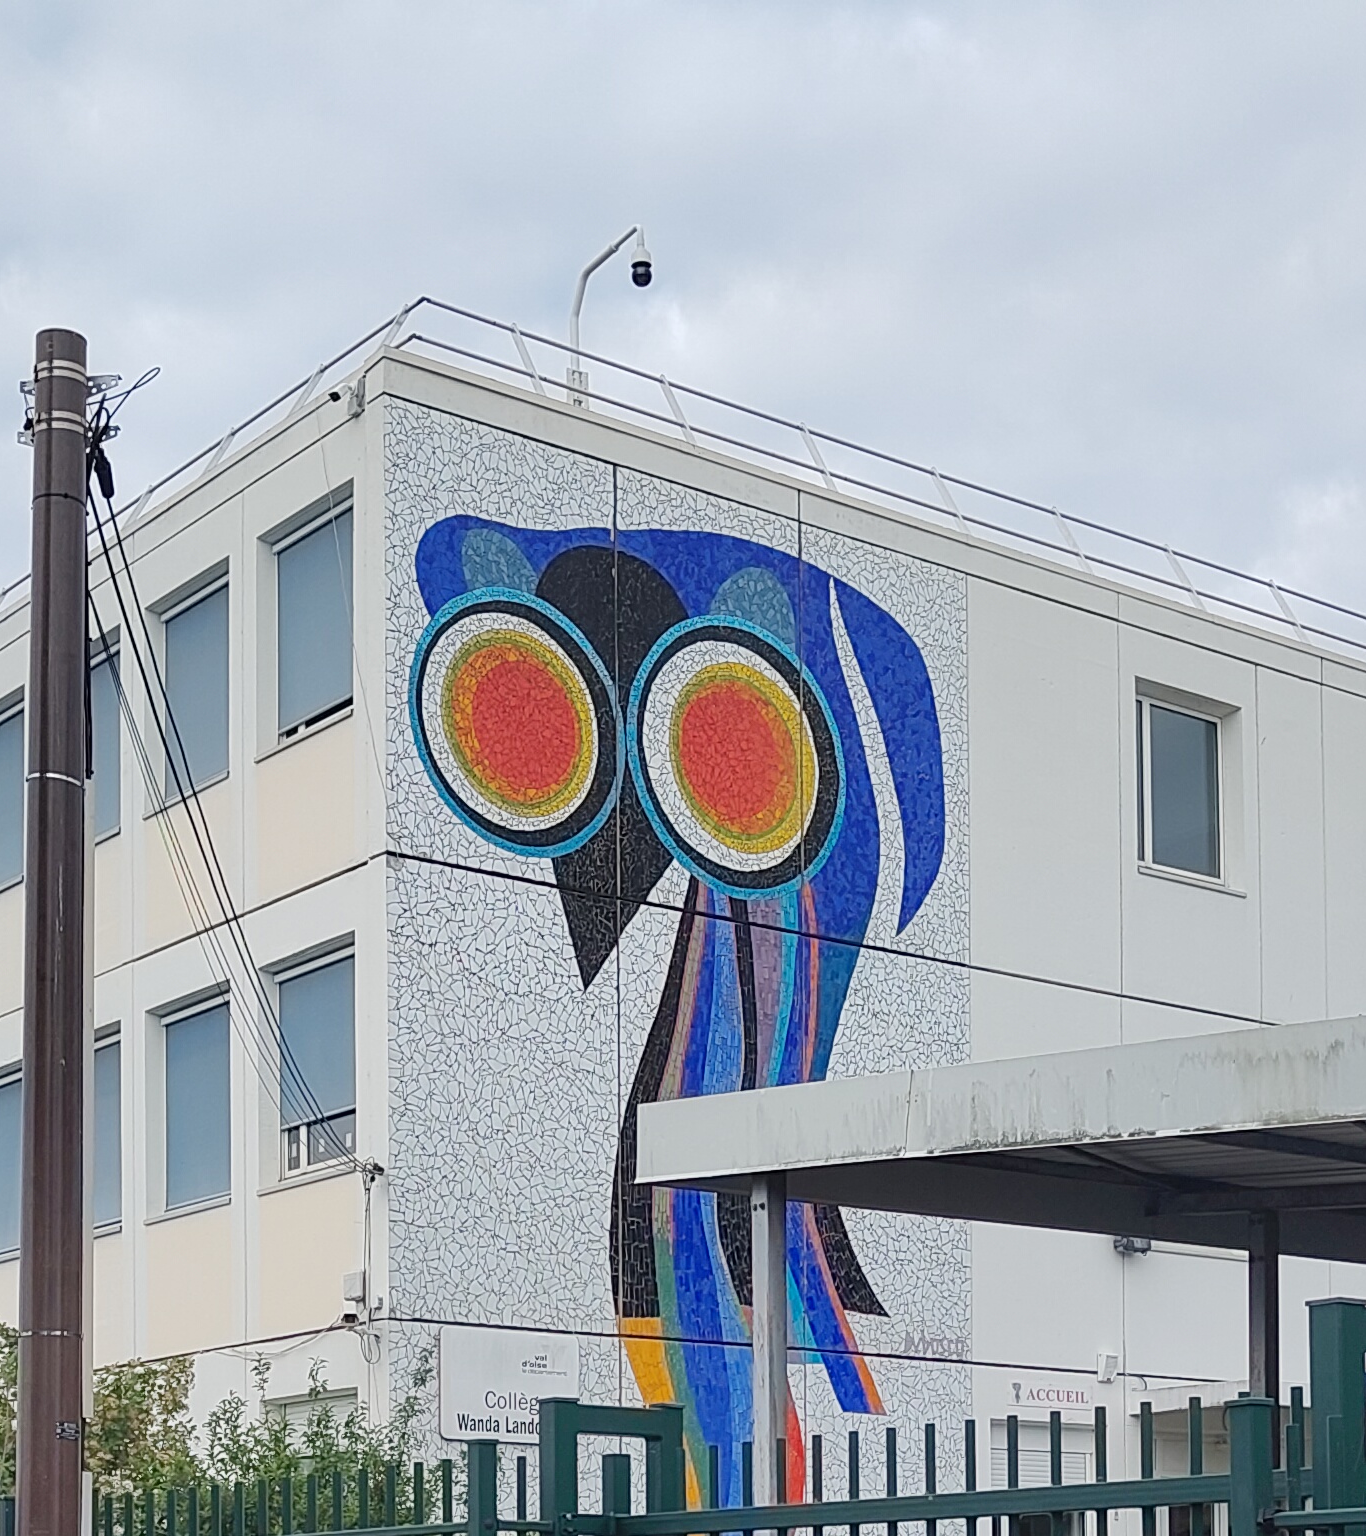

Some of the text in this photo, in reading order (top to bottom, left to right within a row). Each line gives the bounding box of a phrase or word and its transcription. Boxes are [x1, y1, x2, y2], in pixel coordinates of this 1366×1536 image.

[534, 1354, 548, 1362] val
[484, 1391, 540, 1416] Collèg
[1026, 1388, 1089, 1404] ACCUEIL
[457, 1413, 500, 1434] Wanda
